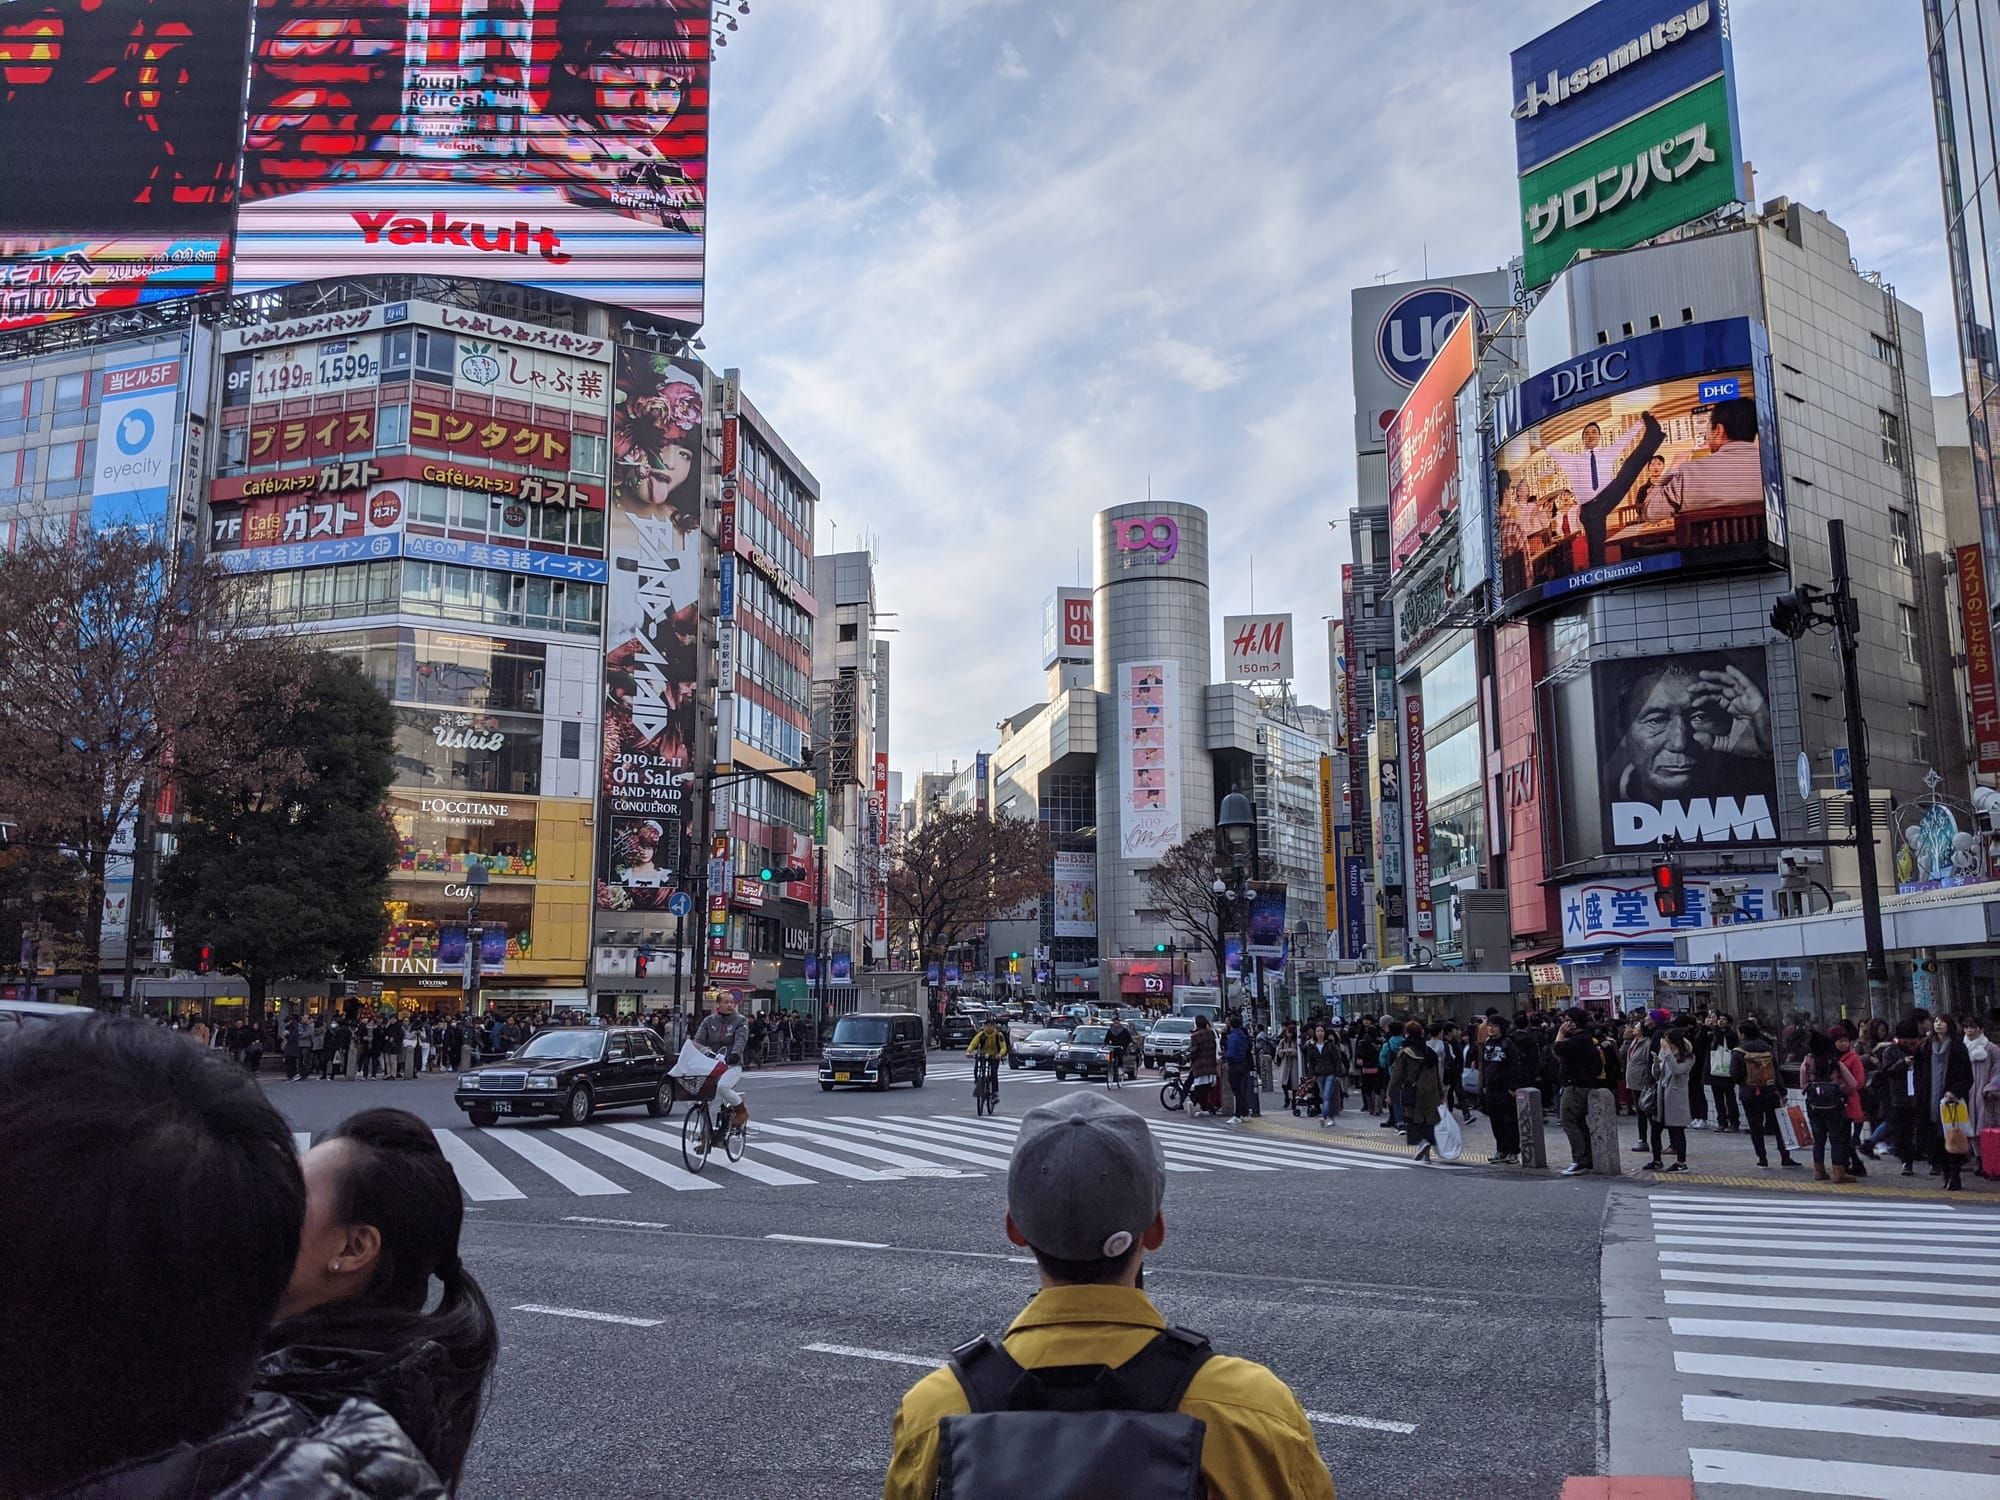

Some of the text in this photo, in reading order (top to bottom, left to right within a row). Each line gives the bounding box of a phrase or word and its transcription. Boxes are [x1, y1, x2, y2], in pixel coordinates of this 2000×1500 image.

[1511, 2, 1710, 119] Hisamitsu
[1525, 122, 1716, 244] サロンパス
[350, 210, 571, 264] Yakult
[240, 309, 372, 346] しゃぶしゃぶバイキング
[441, 308, 605, 356] しゃぶしゃぶバイキング
[109, 365, 172, 391] 当ビル5F
[228, 370, 250, 390] 9F
[257, 364, 312, 399] 1,199円
[319, 352, 379, 389] 1,599円
[509, 356, 603, 400] しゃぶ葉
[1552, 350, 1628, 401] DHC
[1703, 383, 1734, 398] DHC
[252, 414, 371, 456] プライス
[412, 410, 566, 460] コンタクト
[103, 456, 162, 482] eyecity
[242, 461, 380, 496] Caféレストラン ガスト
[423, 465, 589, 508] Caféレストラン ガスト
[214, 518, 242, 540] 7F
[249, 512, 281, 531] Café
[283, 502, 358, 541] ガスト
[372, 506, 398, 518] ガスト
[256, 543, 365, 566] 英会話イーオン
[373, 540, 390, 550] 6F
[1111, 517, 1178, 565] 109
[412, 540, 604, 578] AEON 英会話イーオン
[1569, 562, 1643, 588] DHC Channel
[1962, 550, 1988, 673] クスリのことなら
[1070, 624, 1093, 643] QL
[1232, 622, 1284, 656] H&M
[1238, 664, 1269, 674] 150m
[613, 766, 682, 787] On Sale
[614, 753, 682, 768] 2019.12.11
[612, 786, 681, 800] BAND-MAID
[869, 797, 877, 815] OS
[1612, 795, 1776, 845] DMM
[785, 927, 809, 951] LUSH
[1144, 978, 1163, 993] 109
